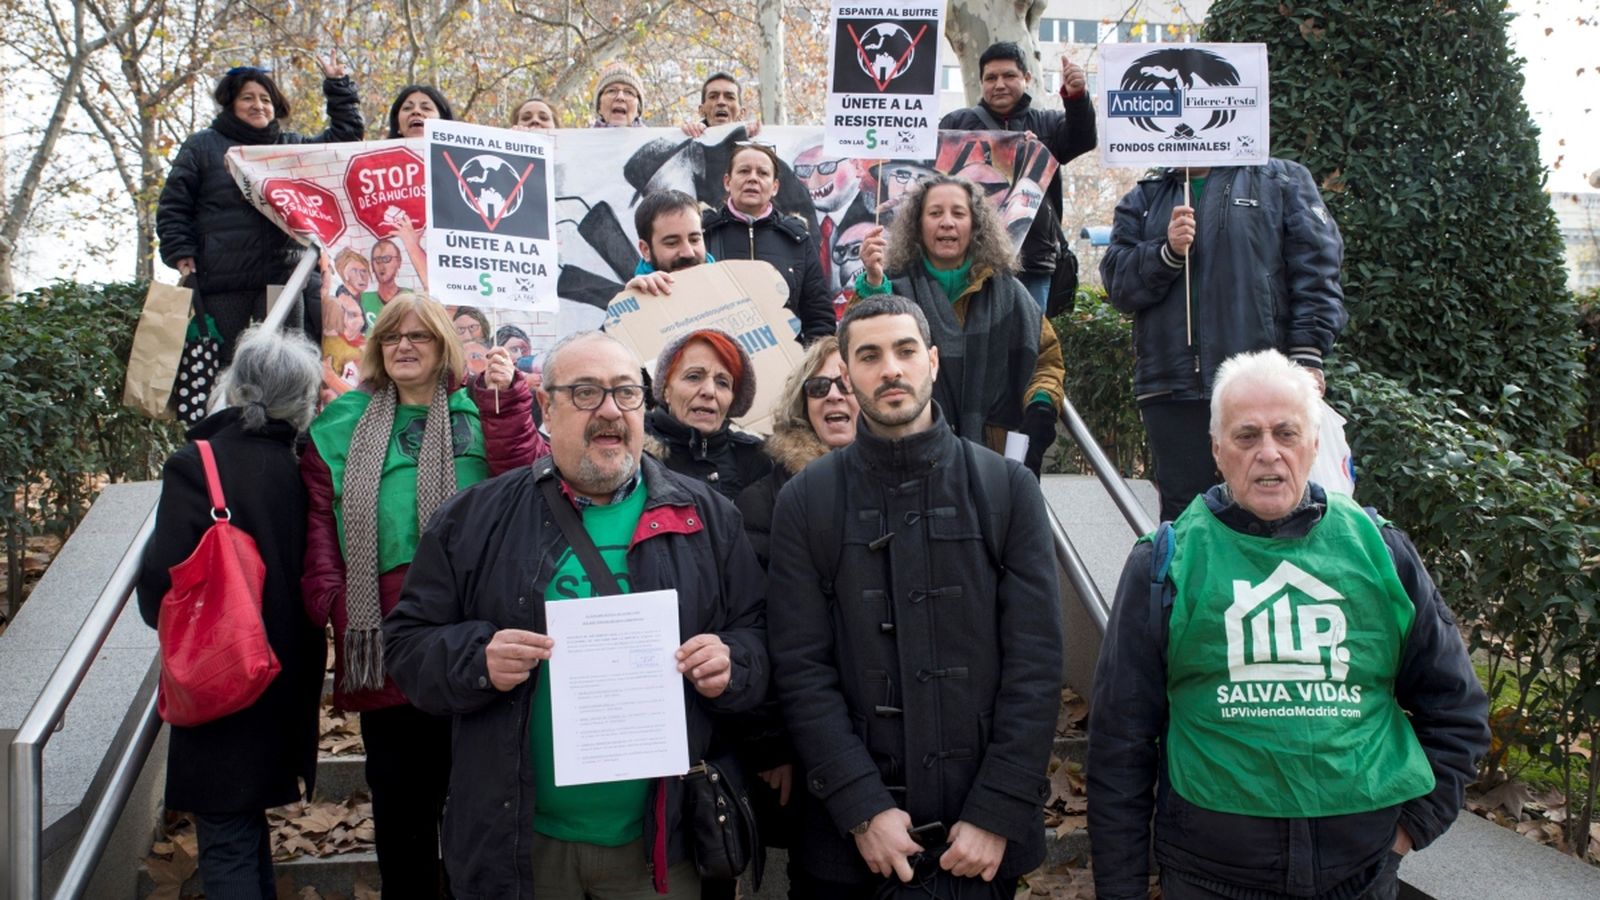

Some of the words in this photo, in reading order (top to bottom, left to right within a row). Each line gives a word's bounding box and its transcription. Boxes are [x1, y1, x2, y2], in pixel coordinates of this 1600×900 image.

[838, 7, 884, 16] ESPANTA
[886, 8, 899, 17] AL
[902, 8, 938, 17] BUITRE
[842, 94, 887, 110] ÚNETE
[890, 98, 901, 110] A
[904, 99, 923, 111] LA
[1111, 94, 1174, 115] Anticipa
[1186, 96, 1256, 107] Fidere-Testa
[834, 115, 928, 128] RESISTENCIA
[432, 131, 485, 147] ESPANTA
[487, 139, 502, 150] AL
[505, 142, 545, 156] BUITRE
[865, 128, 878, 150] S
[1109, 143, 1155, 153] FONDOS
[1157, 141, 1231, 152] CRIMINALES!
[358, 163, 420, 195] STOP
[357, 184, 427, 210] DESAHUCIOS
[445, 231, 500, 252] ÚNETE
[504, 240, 516, 254] A
[520, 242, 540, 257] LA
[438, 254, 548, 278] RESISTENCIA
[479, 272, 494, 297] S
[1216, 682, 1293, 704] SALVA
[1296, 682, 1362, 704] VIDAS
